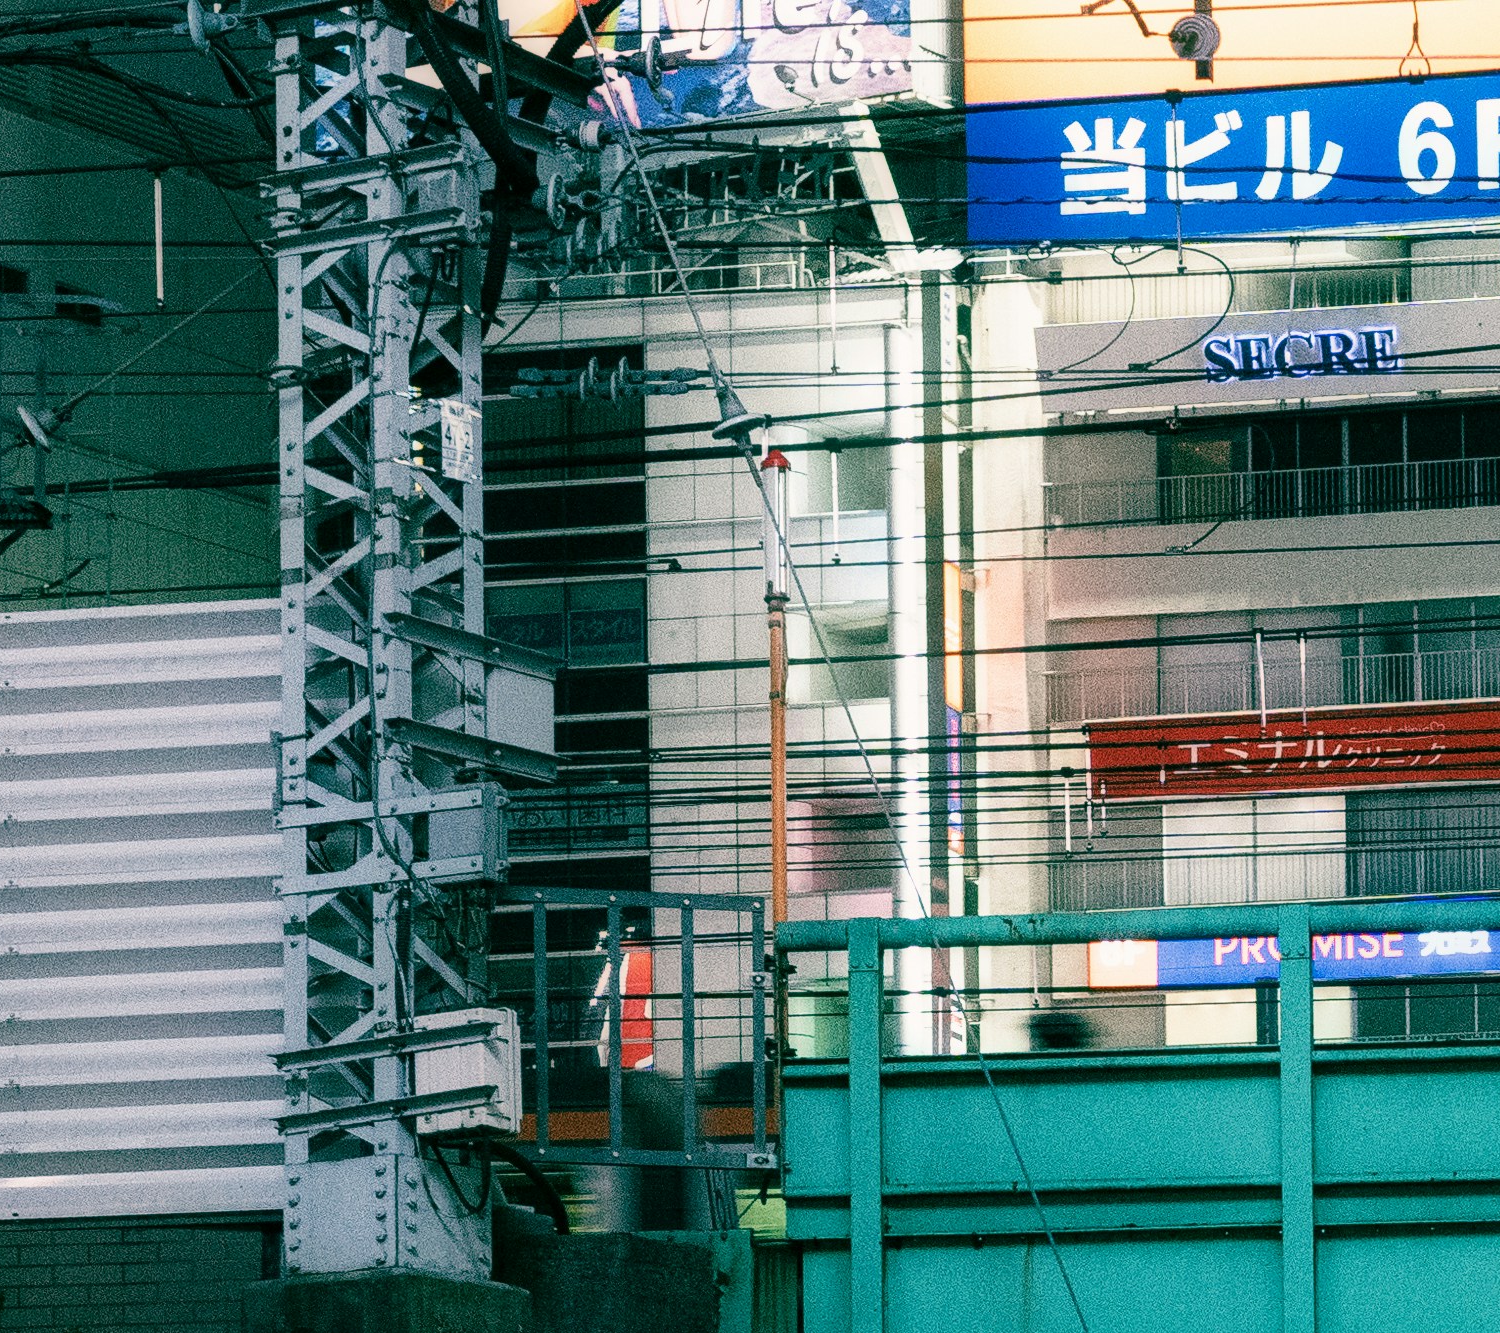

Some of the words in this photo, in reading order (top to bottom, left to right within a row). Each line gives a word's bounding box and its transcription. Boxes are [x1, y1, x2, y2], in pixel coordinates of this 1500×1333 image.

[1060, 109, 1344, 215] 当ビル
[1203, 327, 1397, 383] SECRE
[1214, 933, 1405, 966] PRMISE
